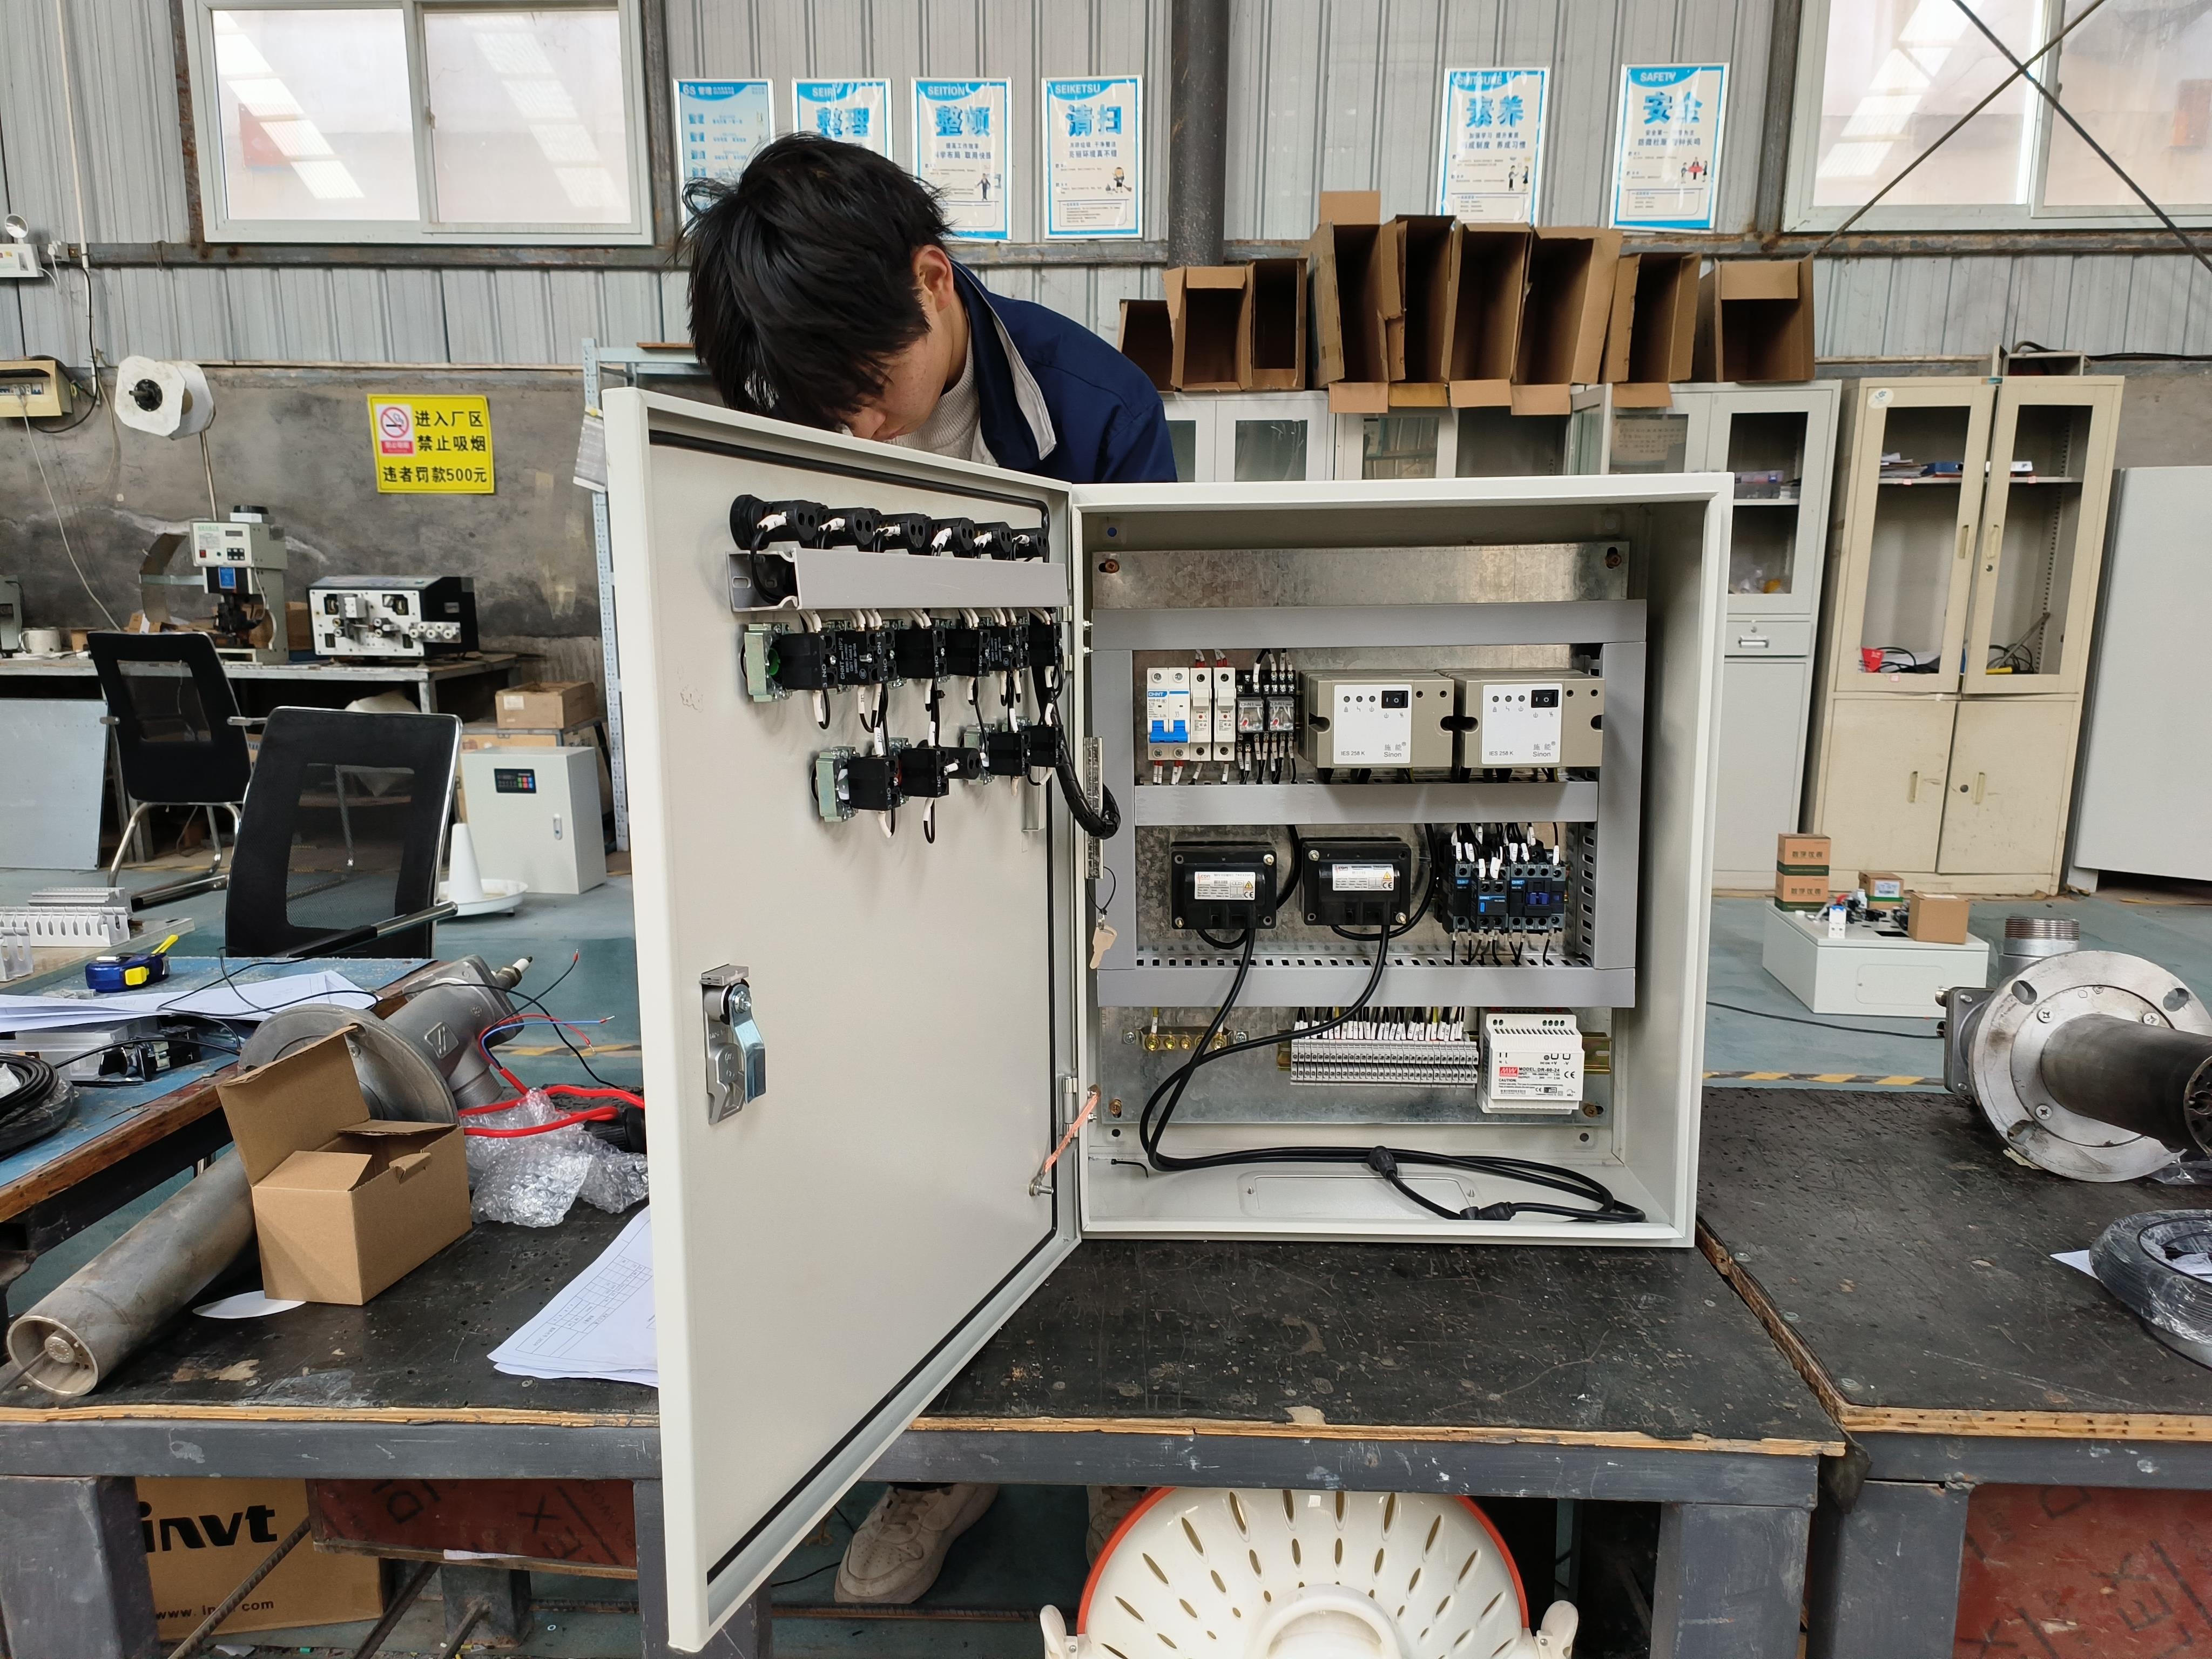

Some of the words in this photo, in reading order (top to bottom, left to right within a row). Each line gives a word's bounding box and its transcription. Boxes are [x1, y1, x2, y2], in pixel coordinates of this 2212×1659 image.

[1641, 72, 1676, 82] SAFETY
[928, 85, 966, 96] SEITION
[1055, 84, 1101, 94] SEIKETSU
[1466, 95, 1524, 128] 素养
[1643, 91, 1703, 125] 安全
[936, 105, 990, 137] 整顿
[1065, 104, 1122, 136] 清扫
[415, 410, 484, 427] 进入厂区
[417, 435, 486, 452] 禁止吸烟
[382, 466, 487, 483] 违者罚款500元
[1016, 635, 1020, 646] NO
[877, 642, 882, 655] NO
[1020, 648, 1023, 659] NO
[1054, 646, 1058, 657] NO
[882, 658, 888, 671] NO
[934, 655, 939, 667] NO
[979, 655, 982, 666] NO
[821, 664, 827, 678] NO
[1022, 757, 1026, 768] NO
[887, 787, 891, 800] NO
[139, 1501, 278, 1553] invt
